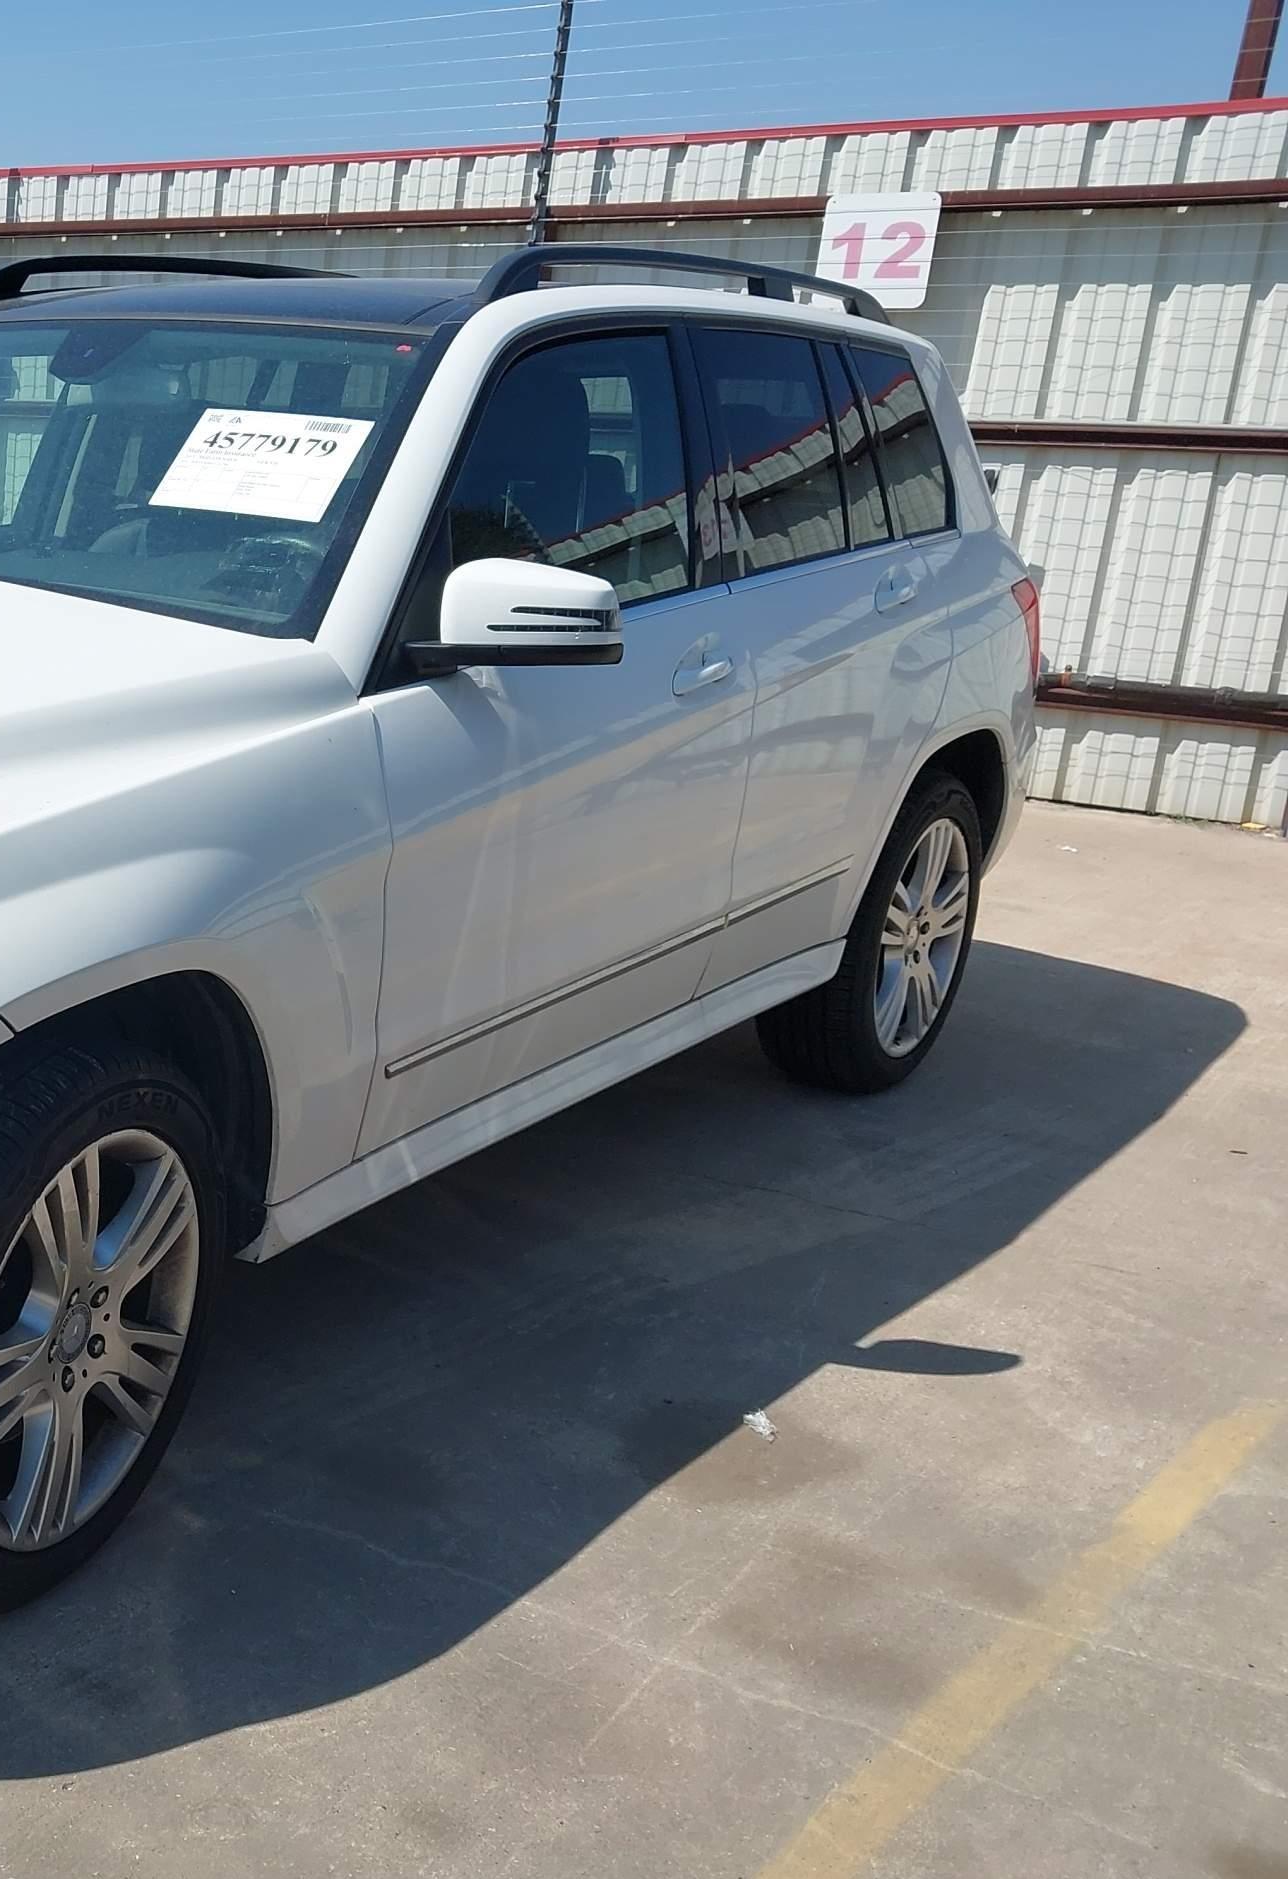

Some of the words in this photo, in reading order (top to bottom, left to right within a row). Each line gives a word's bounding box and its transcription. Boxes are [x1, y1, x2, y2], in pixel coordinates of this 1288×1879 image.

[831, 221, 926, 279] 12
[203, 430, 338, 458] 45779179
[97, 1090, 179, 1121] NEXEN
